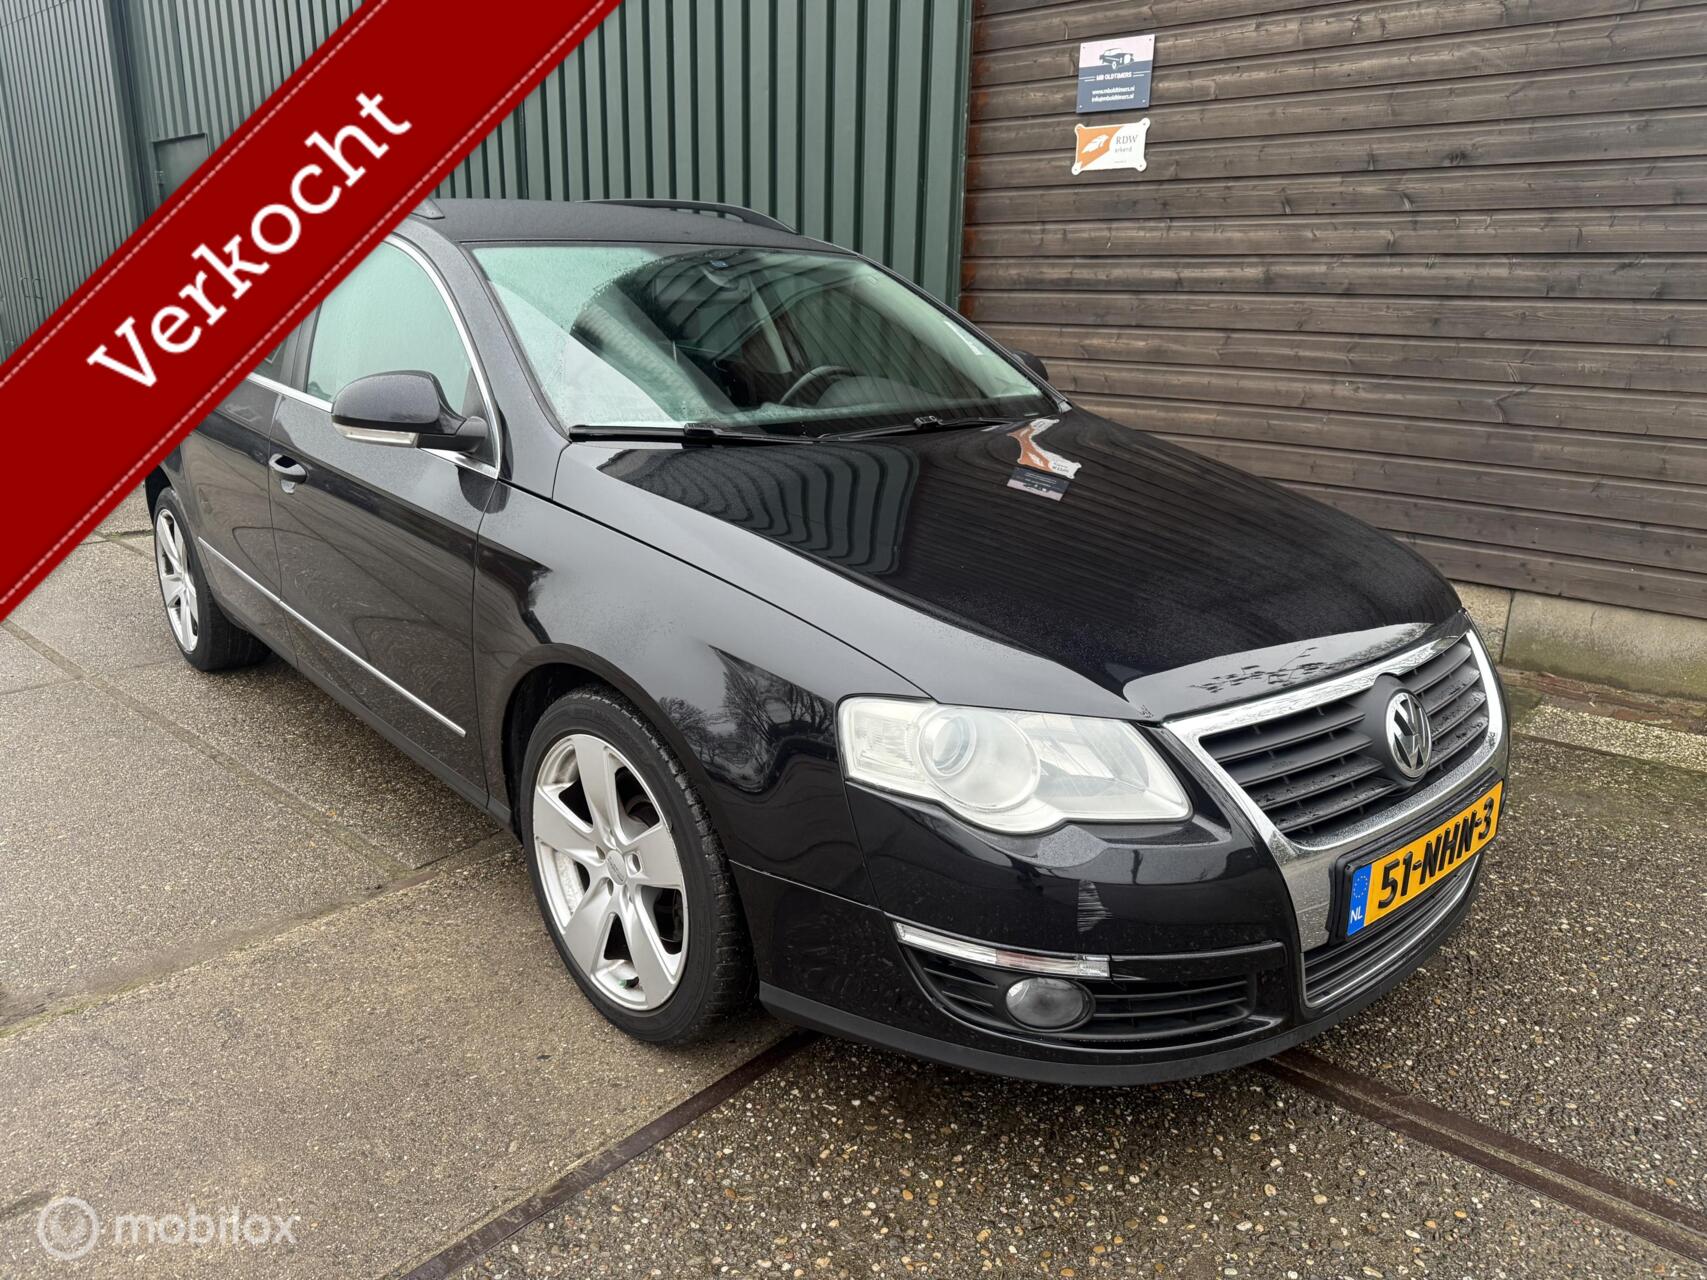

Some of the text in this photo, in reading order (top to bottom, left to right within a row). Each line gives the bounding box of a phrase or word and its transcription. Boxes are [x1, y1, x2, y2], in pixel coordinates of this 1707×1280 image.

[1115, 134, 1139, 145] RDW
[1377, 796, 1495, 909] 51-NHN-3
[1350, 906, 1363, 923] NL
